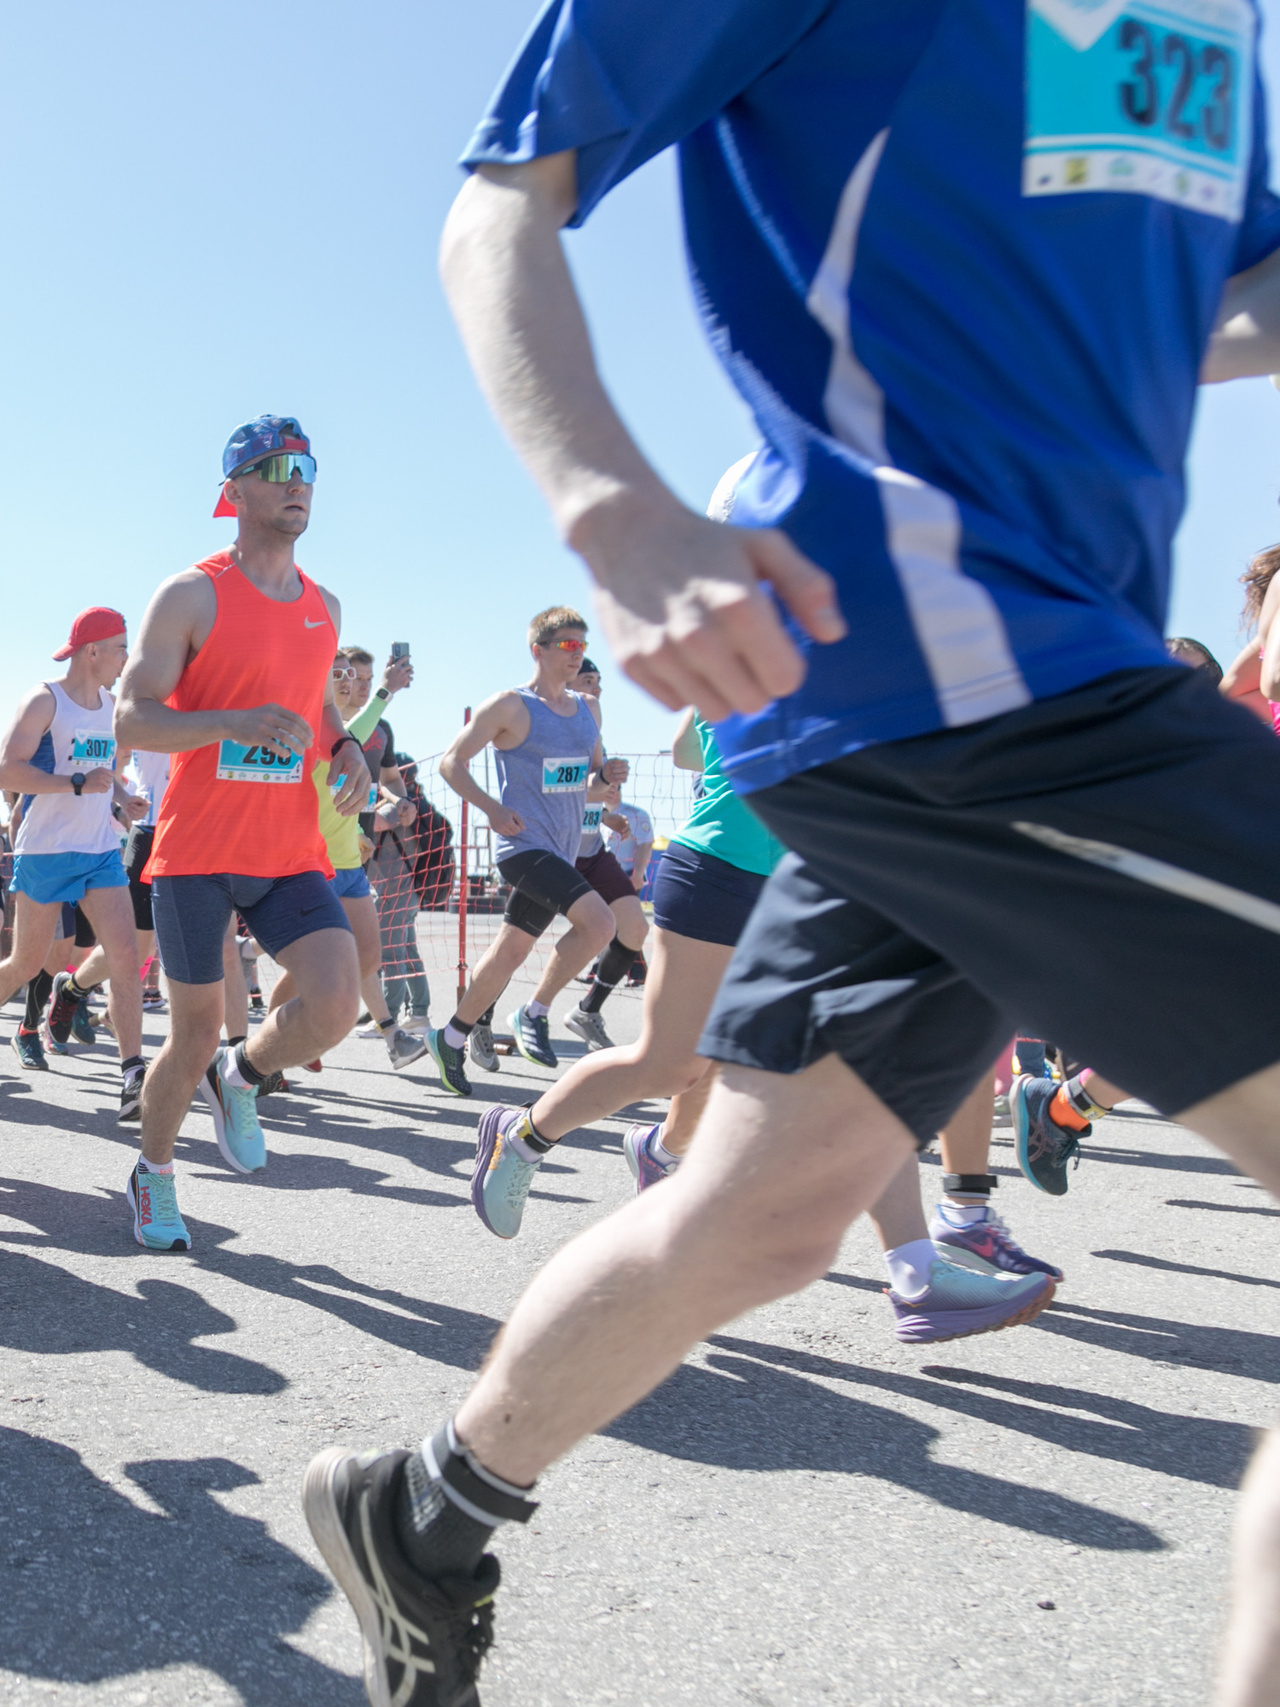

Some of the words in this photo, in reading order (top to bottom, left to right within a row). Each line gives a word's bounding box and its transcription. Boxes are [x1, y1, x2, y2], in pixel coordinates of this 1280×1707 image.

[1118, 18, 1232, 151] 323
[86, 738, 108, 757] 307
[557, 766, 580, 783] 287
[583, 811, 600, 826] 283
[140, 1186, 153, 1227] HOKA
